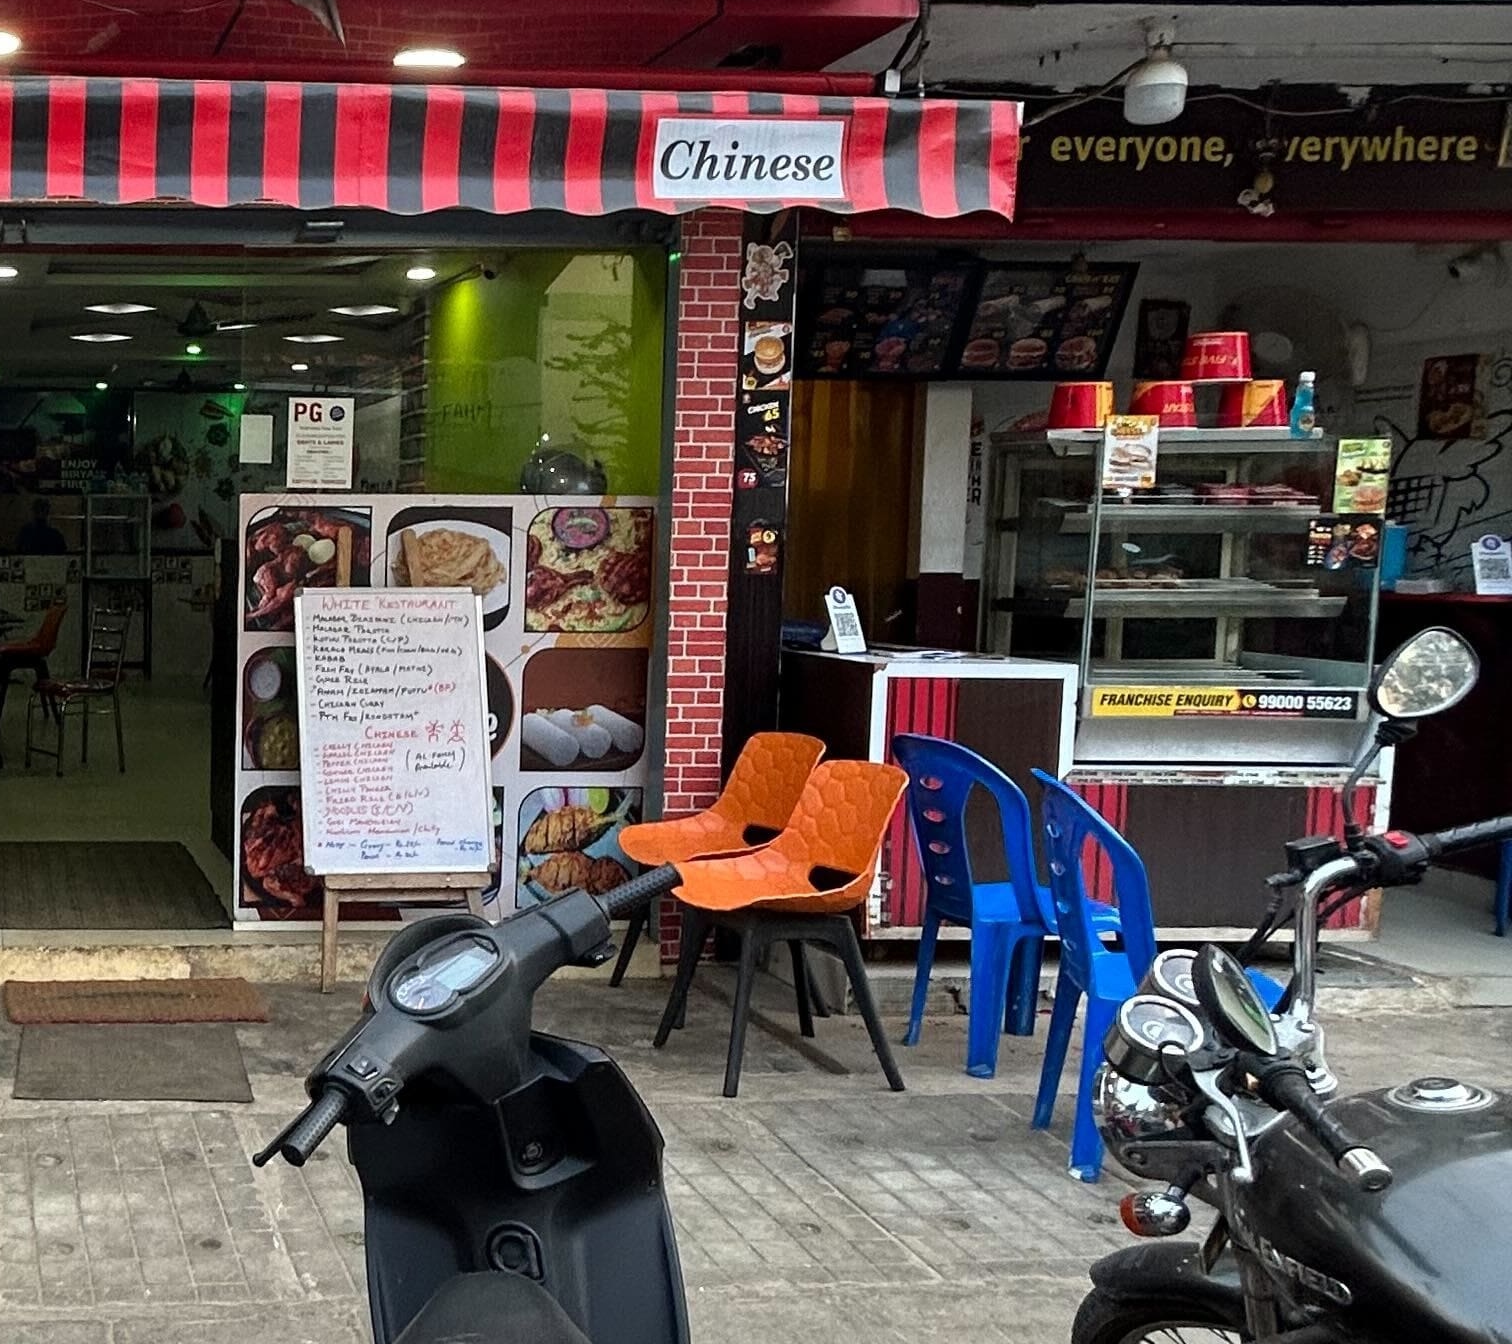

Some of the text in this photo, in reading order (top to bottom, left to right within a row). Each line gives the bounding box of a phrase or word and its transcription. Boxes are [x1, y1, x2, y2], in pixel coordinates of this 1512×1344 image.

[660, 139, 835, 182] Chinese
[1050, 133, 1234, 172] everyone,
[294, 402, 323, 423] PG
[742, 472, 757, 484] 75
[322, 596, 370, 612] WHITE
[1100, 693, 1353, 711] FRANCHISE ENQUIRY 99000 55623
[364, 725, 420, 739] CHINESE
